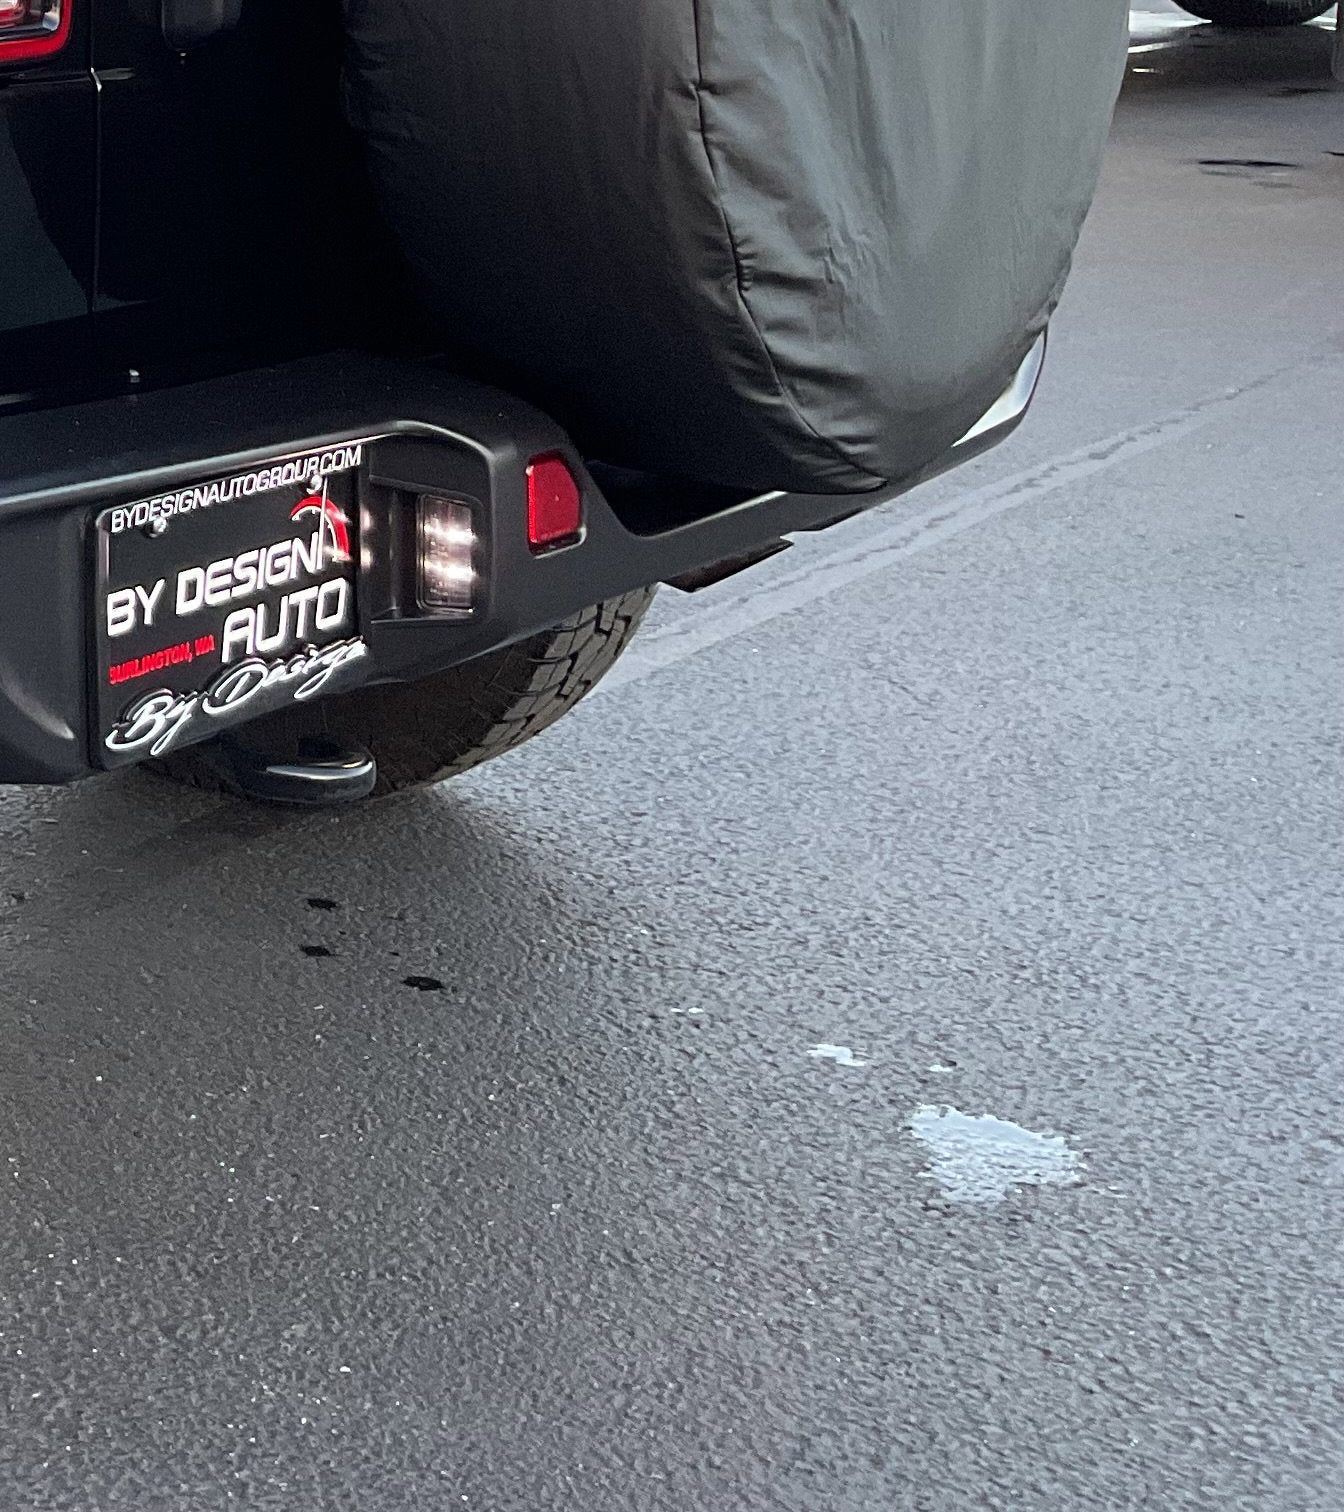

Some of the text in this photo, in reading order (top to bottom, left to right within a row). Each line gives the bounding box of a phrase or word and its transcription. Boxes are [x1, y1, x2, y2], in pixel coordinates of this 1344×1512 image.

[107, 532, 325, 636] BY DESIGN
[221, 577, 348, 663] AUTO
[194, 634, 215, 657] WA
[105, 638, 367, 756] By Design
